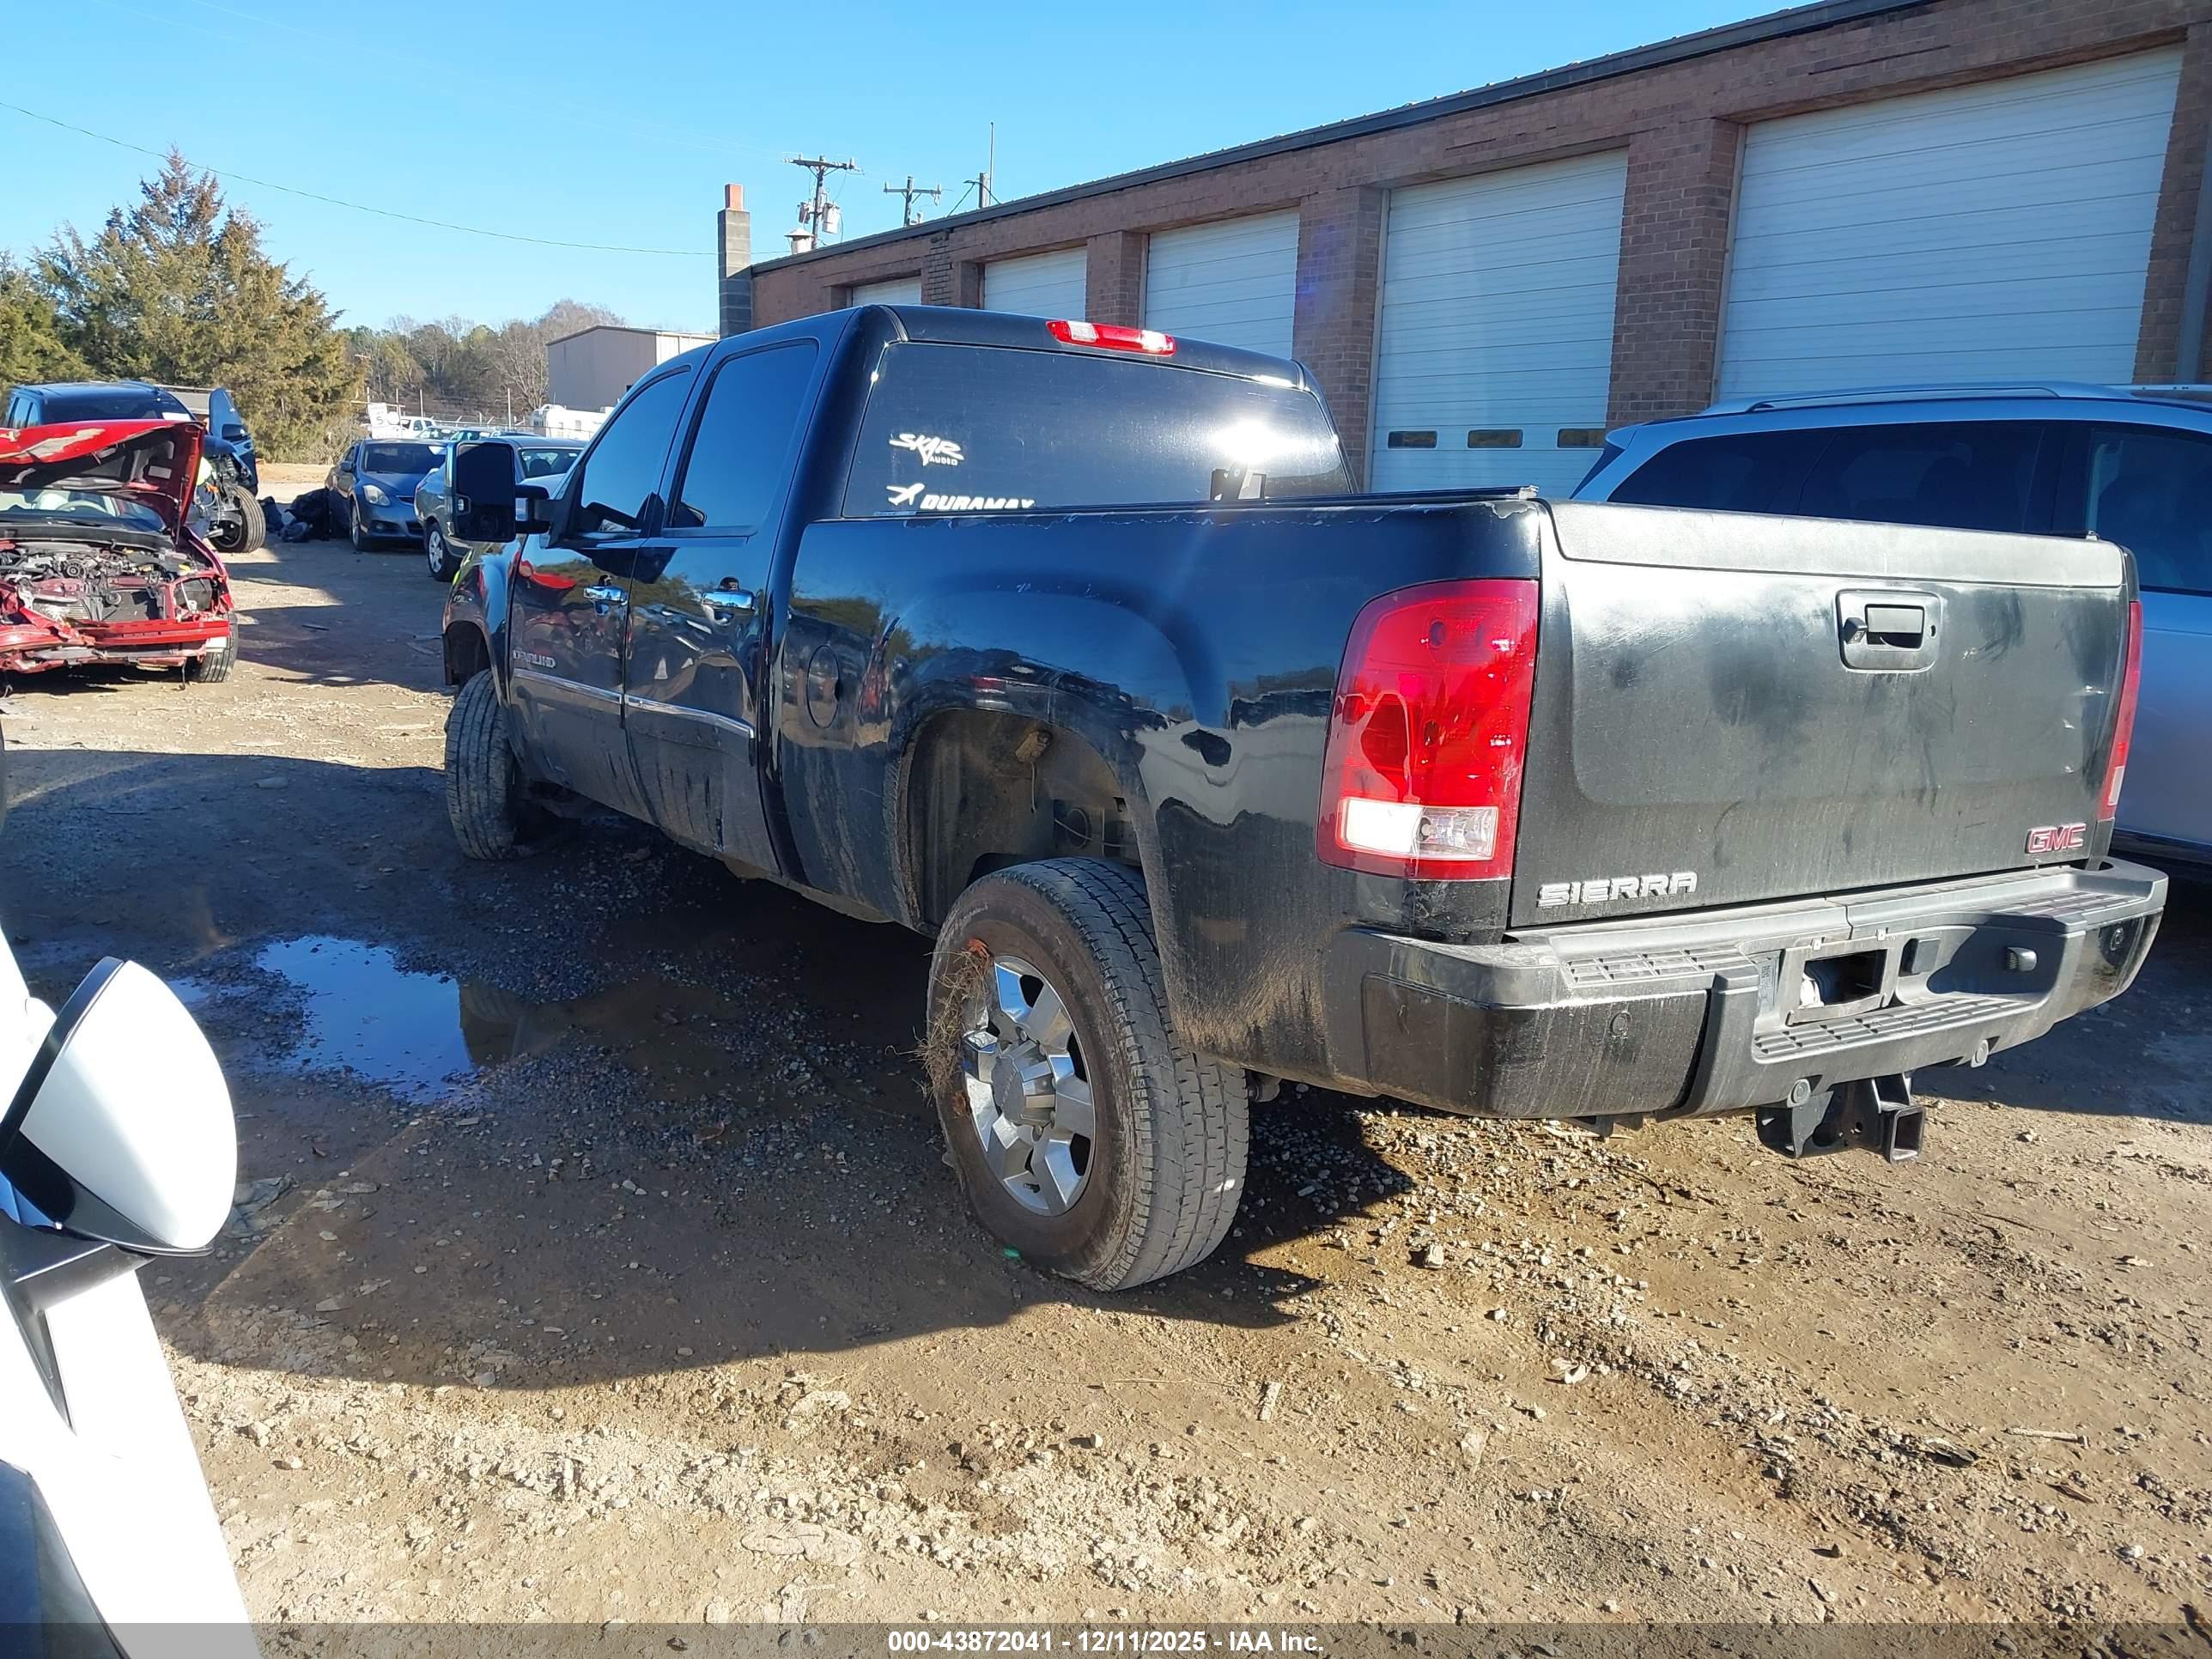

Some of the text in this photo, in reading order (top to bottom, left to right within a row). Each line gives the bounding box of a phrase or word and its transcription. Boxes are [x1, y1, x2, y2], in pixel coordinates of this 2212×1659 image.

[889, 433, 964, 466] SKAR
[929, 455, 958, 466] AUDIO
[2026, 823, 2087, 854] GMC
[1536, 872, 1698, 908] SIERRA
